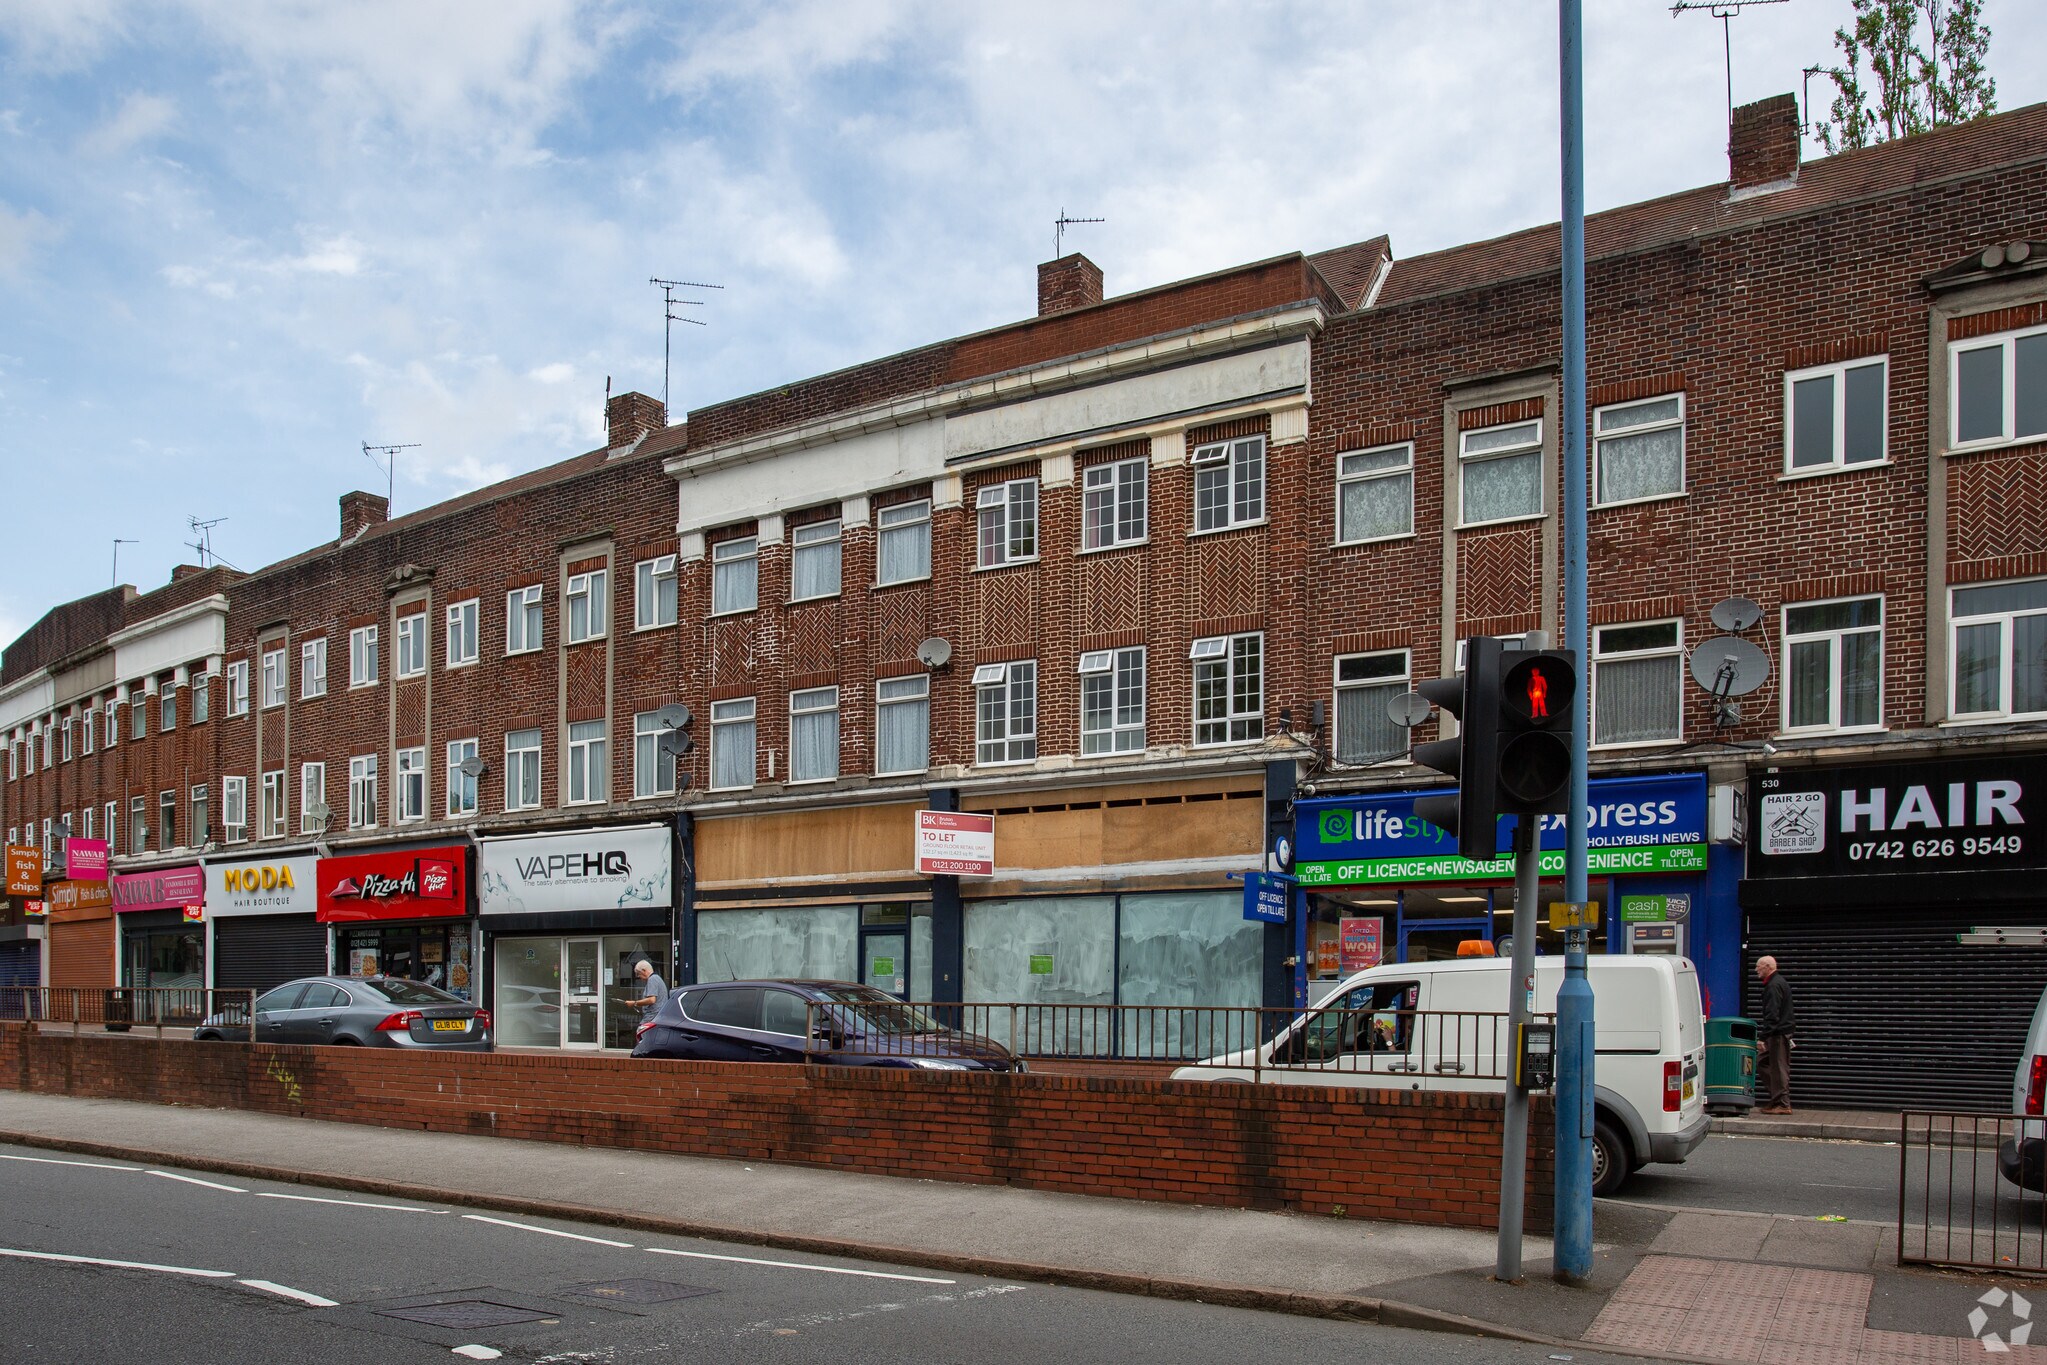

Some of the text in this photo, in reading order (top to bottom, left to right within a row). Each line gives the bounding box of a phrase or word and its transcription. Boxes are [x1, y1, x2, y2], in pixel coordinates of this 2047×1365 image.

[1762, 780, 1779, 788] 530
[1841, 780, 2025, 832] HAIR
[922, 815, 936, 825] BK
[922, 832, 955, 842] TO LET
[1587, 832, 1699, 847] HOLLYBUSH NEWS
[1770, 836, 1817, 847] BARBER SHOP
[11, 848, 39, 858] Simply
[72, 849, 105, 858] NAWAB
[1670, 849, 1693, 858] OPEN
[1849, 836, 2022, 860] 0742 626 9549
[16, 860, 35, 870] fish
[515, 850, 632, 880] VAPEHQ
[932, 861, 981, 870] 0121 200 1100
[1337, 852, 1653, 879] OFF LICENCE NEWSAGEN COENIENCE
[1661, 858, 1702, 867] TILL LATE
[1305, 865, 1325, 874] OPEN
[21, 871, 29, 880] &
[224, 864, 295, 893] MODA
[424, 873, 447, 885] Pizza
[537, 879, 552, 887] tasty
[600, 875, 627, 884] smoking
[1299, 873, 1332, 883] TILL LATE
[11, 882, 39, 893] chips
[113, 878, 165, 906] NAWAB
[360, 874, 399, 900] Pizza
[428, 882, 446, 892] Hut
[52, 882, 108, 907] Simply fish & chips
[1259, 891, 1283, 904] OFF LICENCE
[234, 897, 290, 907] HAIR BOUTIQUE
[1627, 899, 1659, 911] cash
[1256, 903, 1285, 917] OPEN TILL LATE
[1345, 942, 1376, 953] WON
[435, 1020, 463, 1029] GL18 CLY
